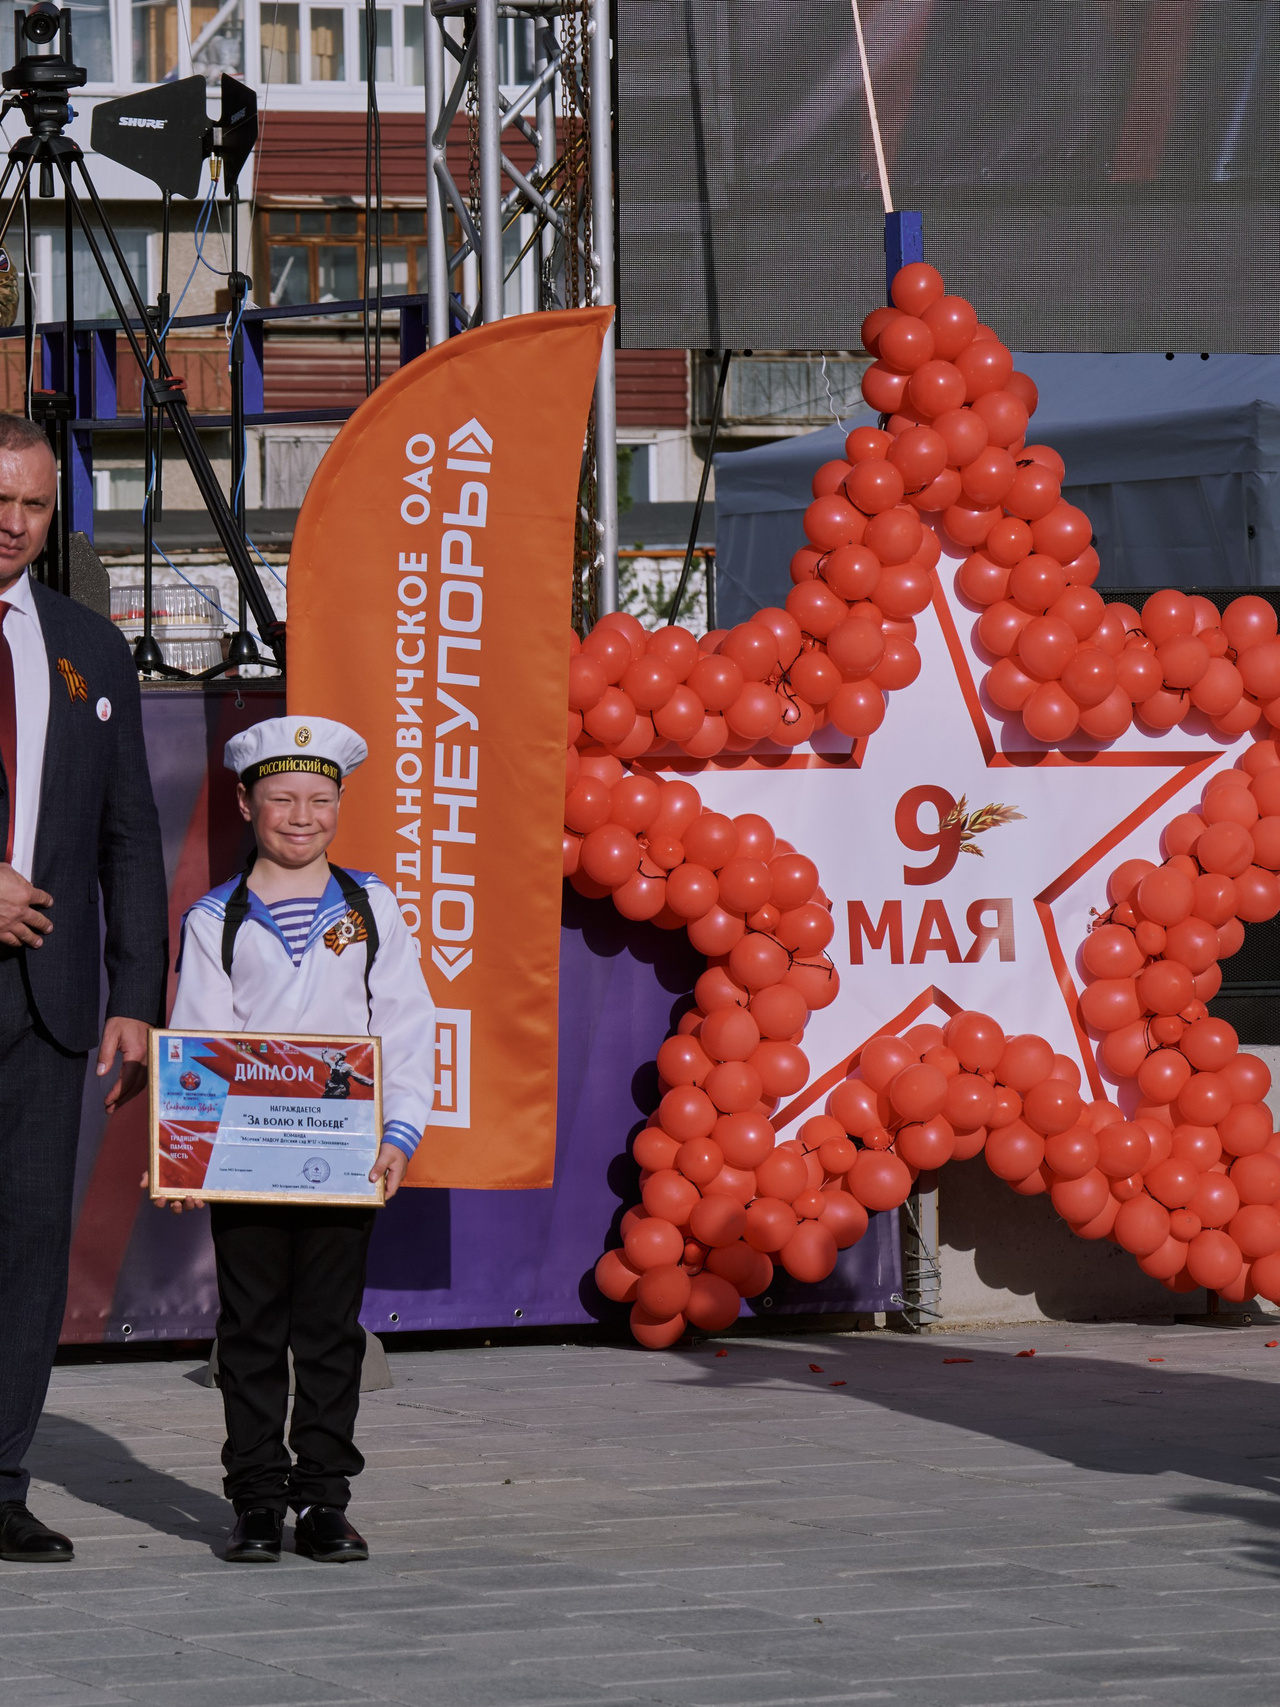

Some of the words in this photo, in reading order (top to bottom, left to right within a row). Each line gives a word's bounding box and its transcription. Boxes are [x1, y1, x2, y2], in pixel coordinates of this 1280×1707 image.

[119, 116, 165, 129] SHURE
[402, 433, 436, 525] ОАО
[259, 757, 321, 777] РОССИЙСКИЙ
[322, 763, 338, 780] ФЛОТ
[894, 784, 962, 886] 9
[847, 897, 1016, 965] МАЯ
[234, 1063, 315, 1082] ДИПЛОМ
[270, 1105, 321, 1114] НАГРАЖДАЕТСЯ
[170, 1143, 193, 1151] ПАМЯТЬ
